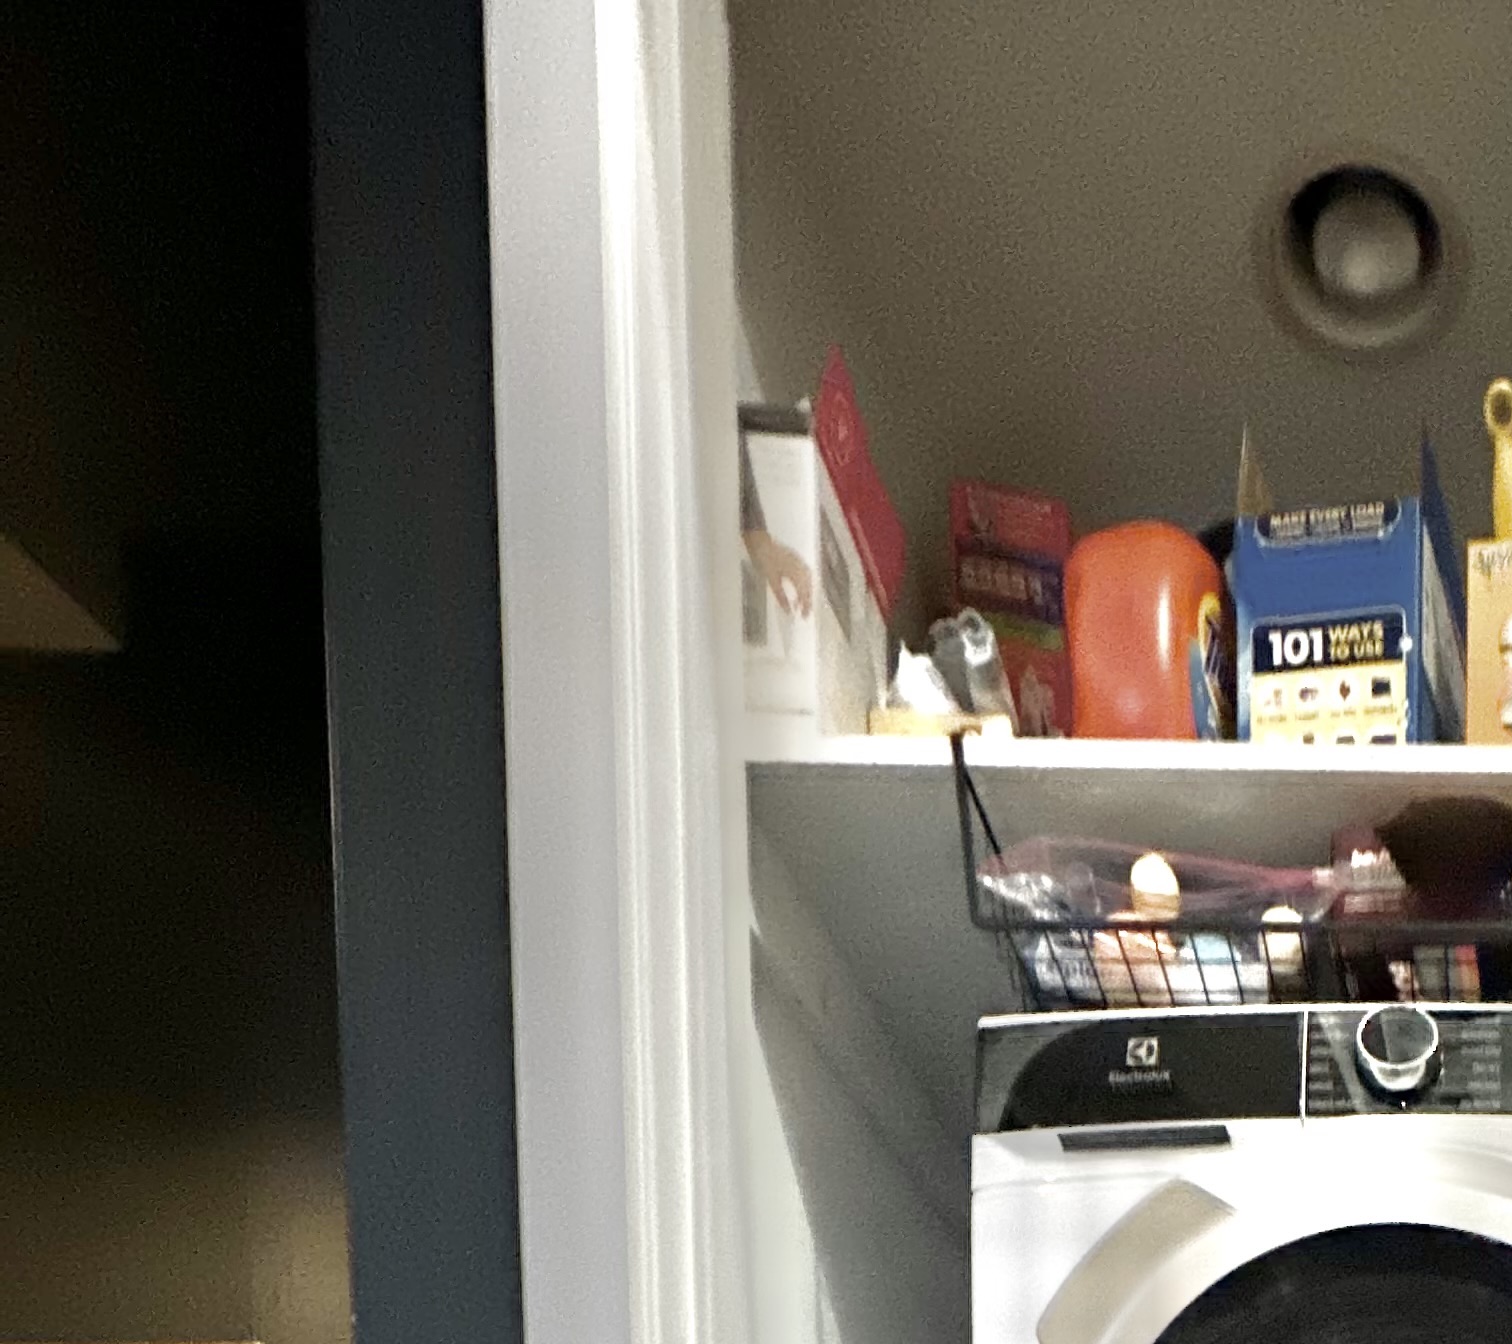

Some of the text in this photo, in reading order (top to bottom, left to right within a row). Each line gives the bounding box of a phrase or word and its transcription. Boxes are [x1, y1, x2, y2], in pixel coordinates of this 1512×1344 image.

[1268, 620, 1383, 666] 101 WAYS
[1330, 638, 1384, 661] TO USE
